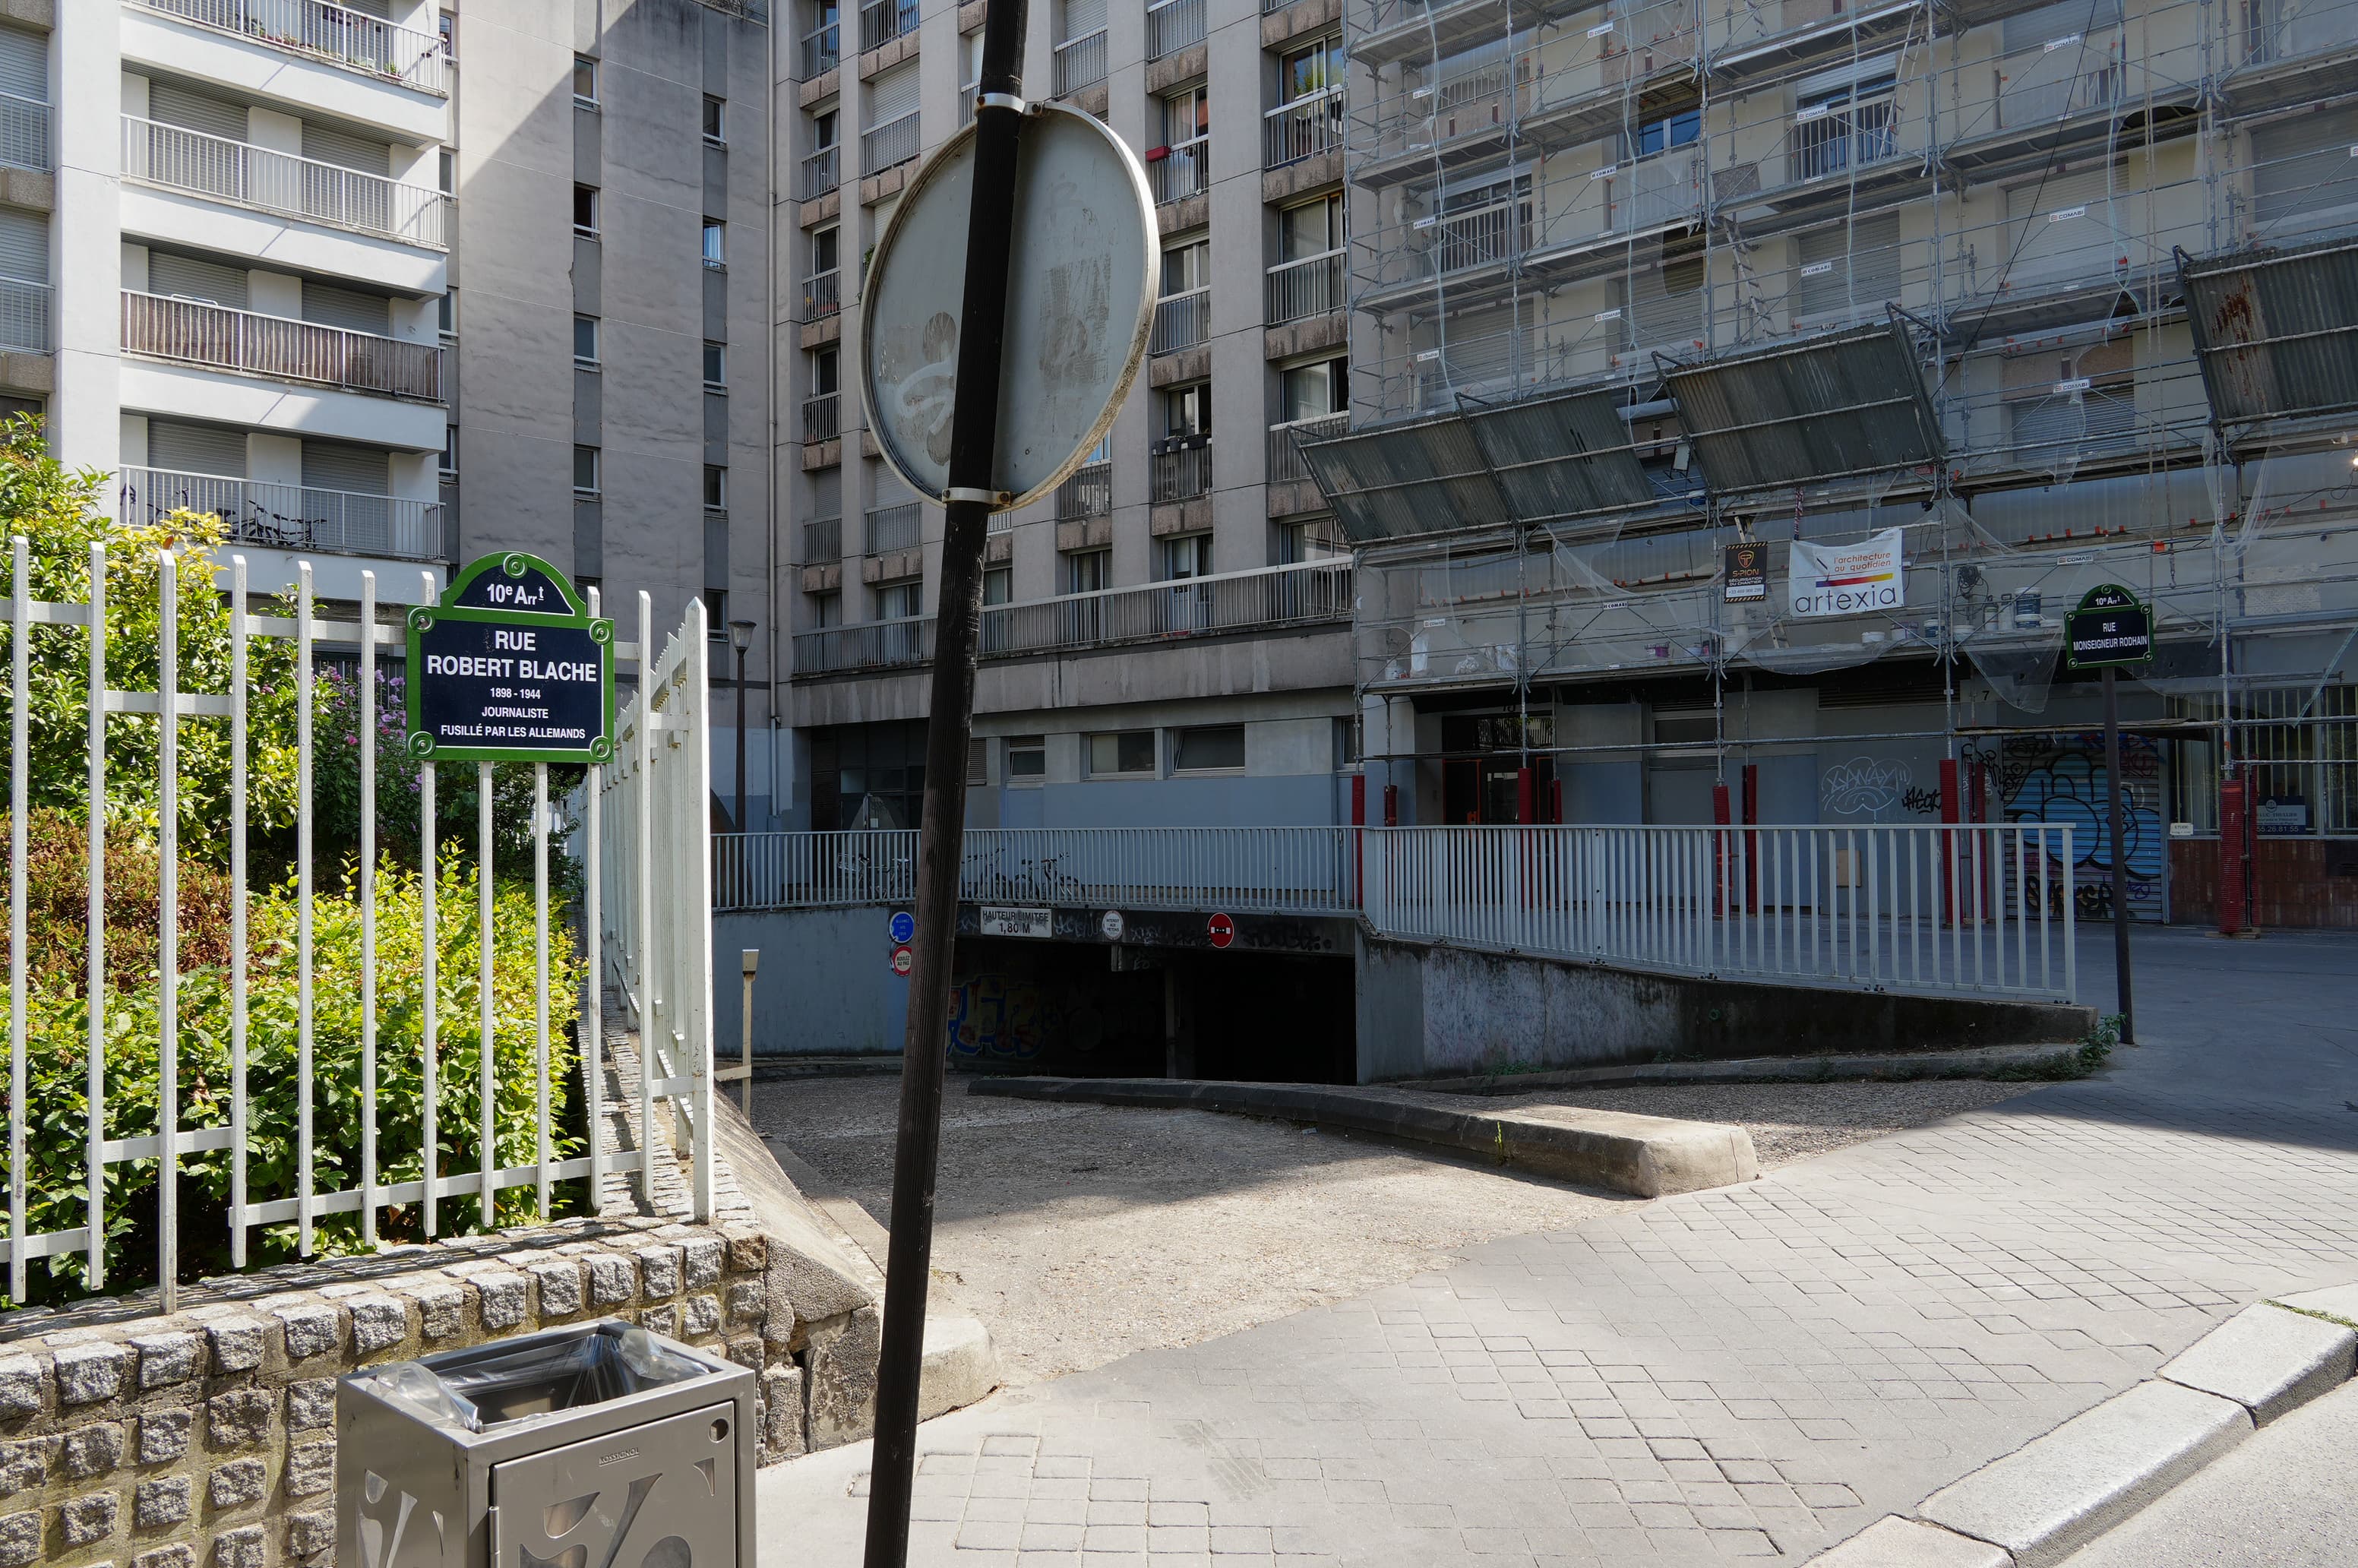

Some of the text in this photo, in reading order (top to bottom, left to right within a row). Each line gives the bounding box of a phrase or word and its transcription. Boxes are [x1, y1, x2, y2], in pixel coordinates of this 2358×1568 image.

[2054, 39, 2078, 49] COMABI
[1596, 168, 1616, 177] COMABI
[2059, 210, 2084, 220] COMABI
[1808, 264, 1830, 273] COMABI
[2063, 382, 2088, 390] COMABI
[1834, 552, 1891, 564] l'architecture
[1850, 560, 1891, 572] quotidien
[1795, 585, 1897, 613] artexia
[2103, 622, 2116, 633] RUE
[495, 631, 536, 651] RUE
[2073, 635, 2148, 651] MONSEIGNEUR RODHAIN
[427, 655, 597, 682] ROBERT BLACHE
[490, 688, 512, 698] 1898
[520, 689, 541, 699] 1944
[482, 707, 548, 719] JOURNALISTE
[441, 723, 586, 739] FUSILLÉ PAR LES ALLEMANDS
[983, 910, 1016, 920] HAUTEUR
[1000, 922, 1031, 934] 1,80 M
[598, 1447, 640, 1465] ROSSIGNOL
